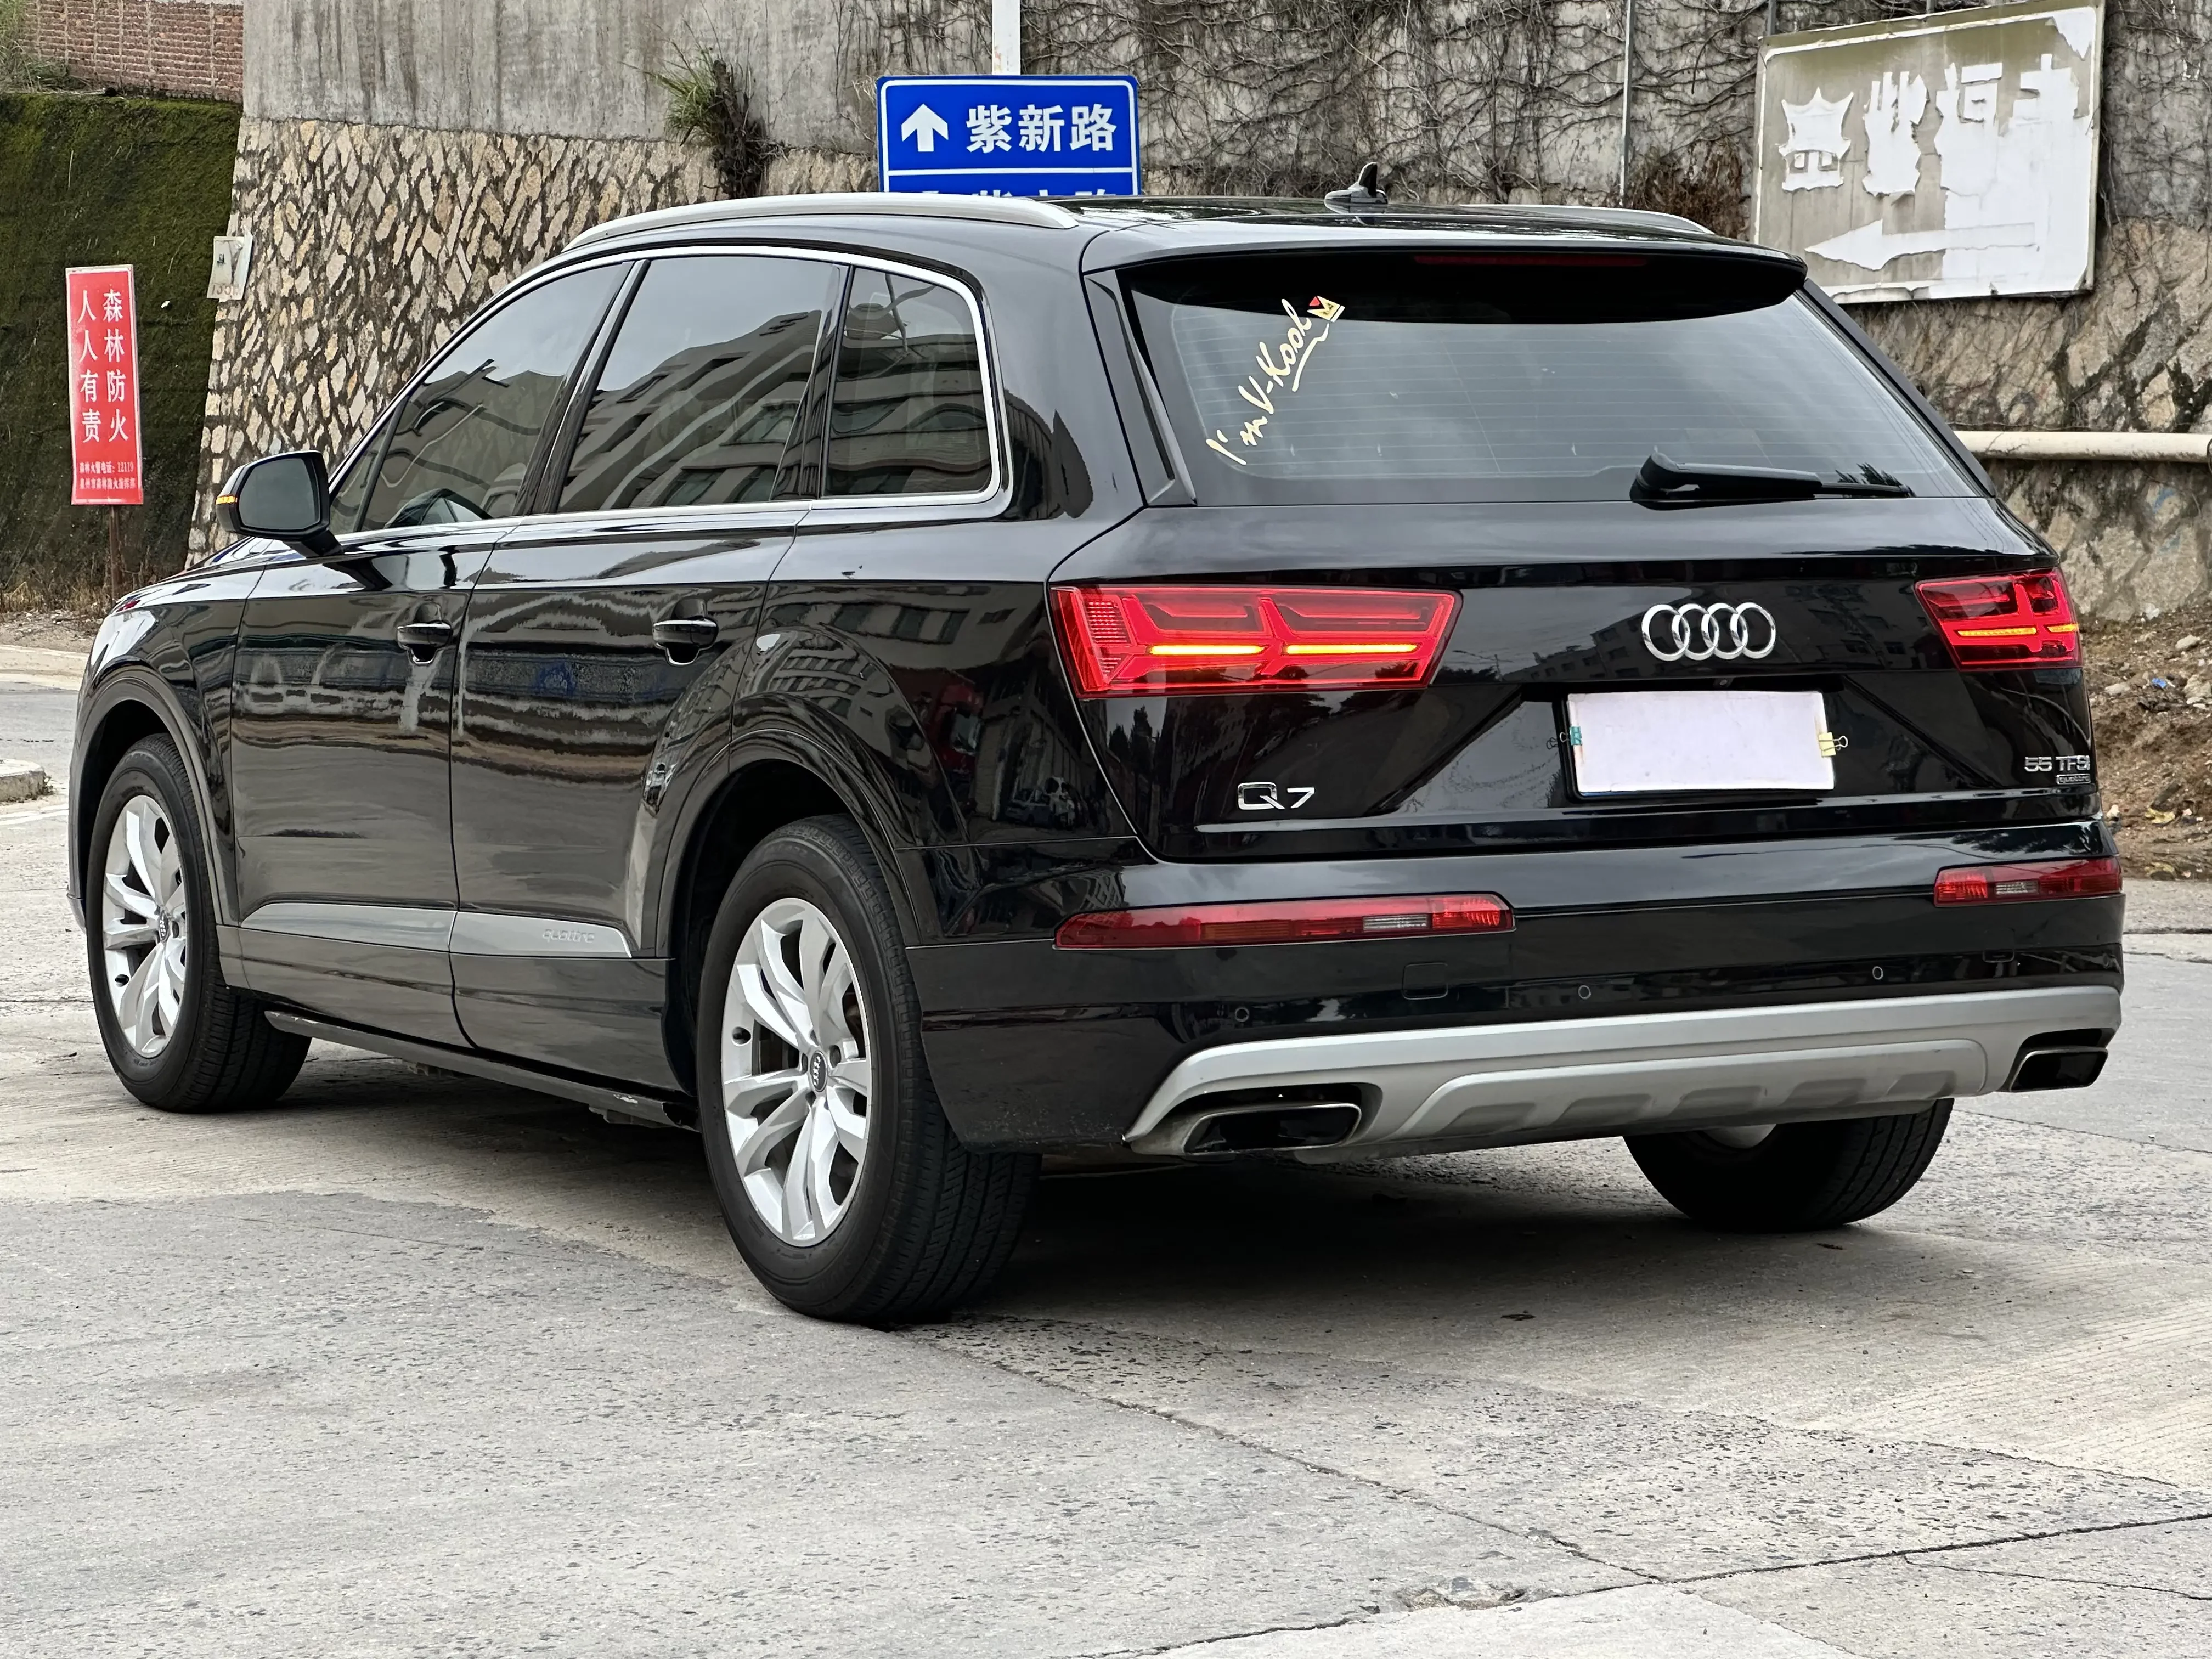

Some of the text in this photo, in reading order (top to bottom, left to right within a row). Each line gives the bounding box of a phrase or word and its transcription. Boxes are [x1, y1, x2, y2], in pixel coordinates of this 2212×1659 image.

[966, 103, 1118, 154] 紫新路
[77, 289, 101, 443] 人人有责
[101, 289, 129, 442] 森林防火
[2024, 757, 2052, 772] 55
[1237, 782, 1315, 810] Q7
